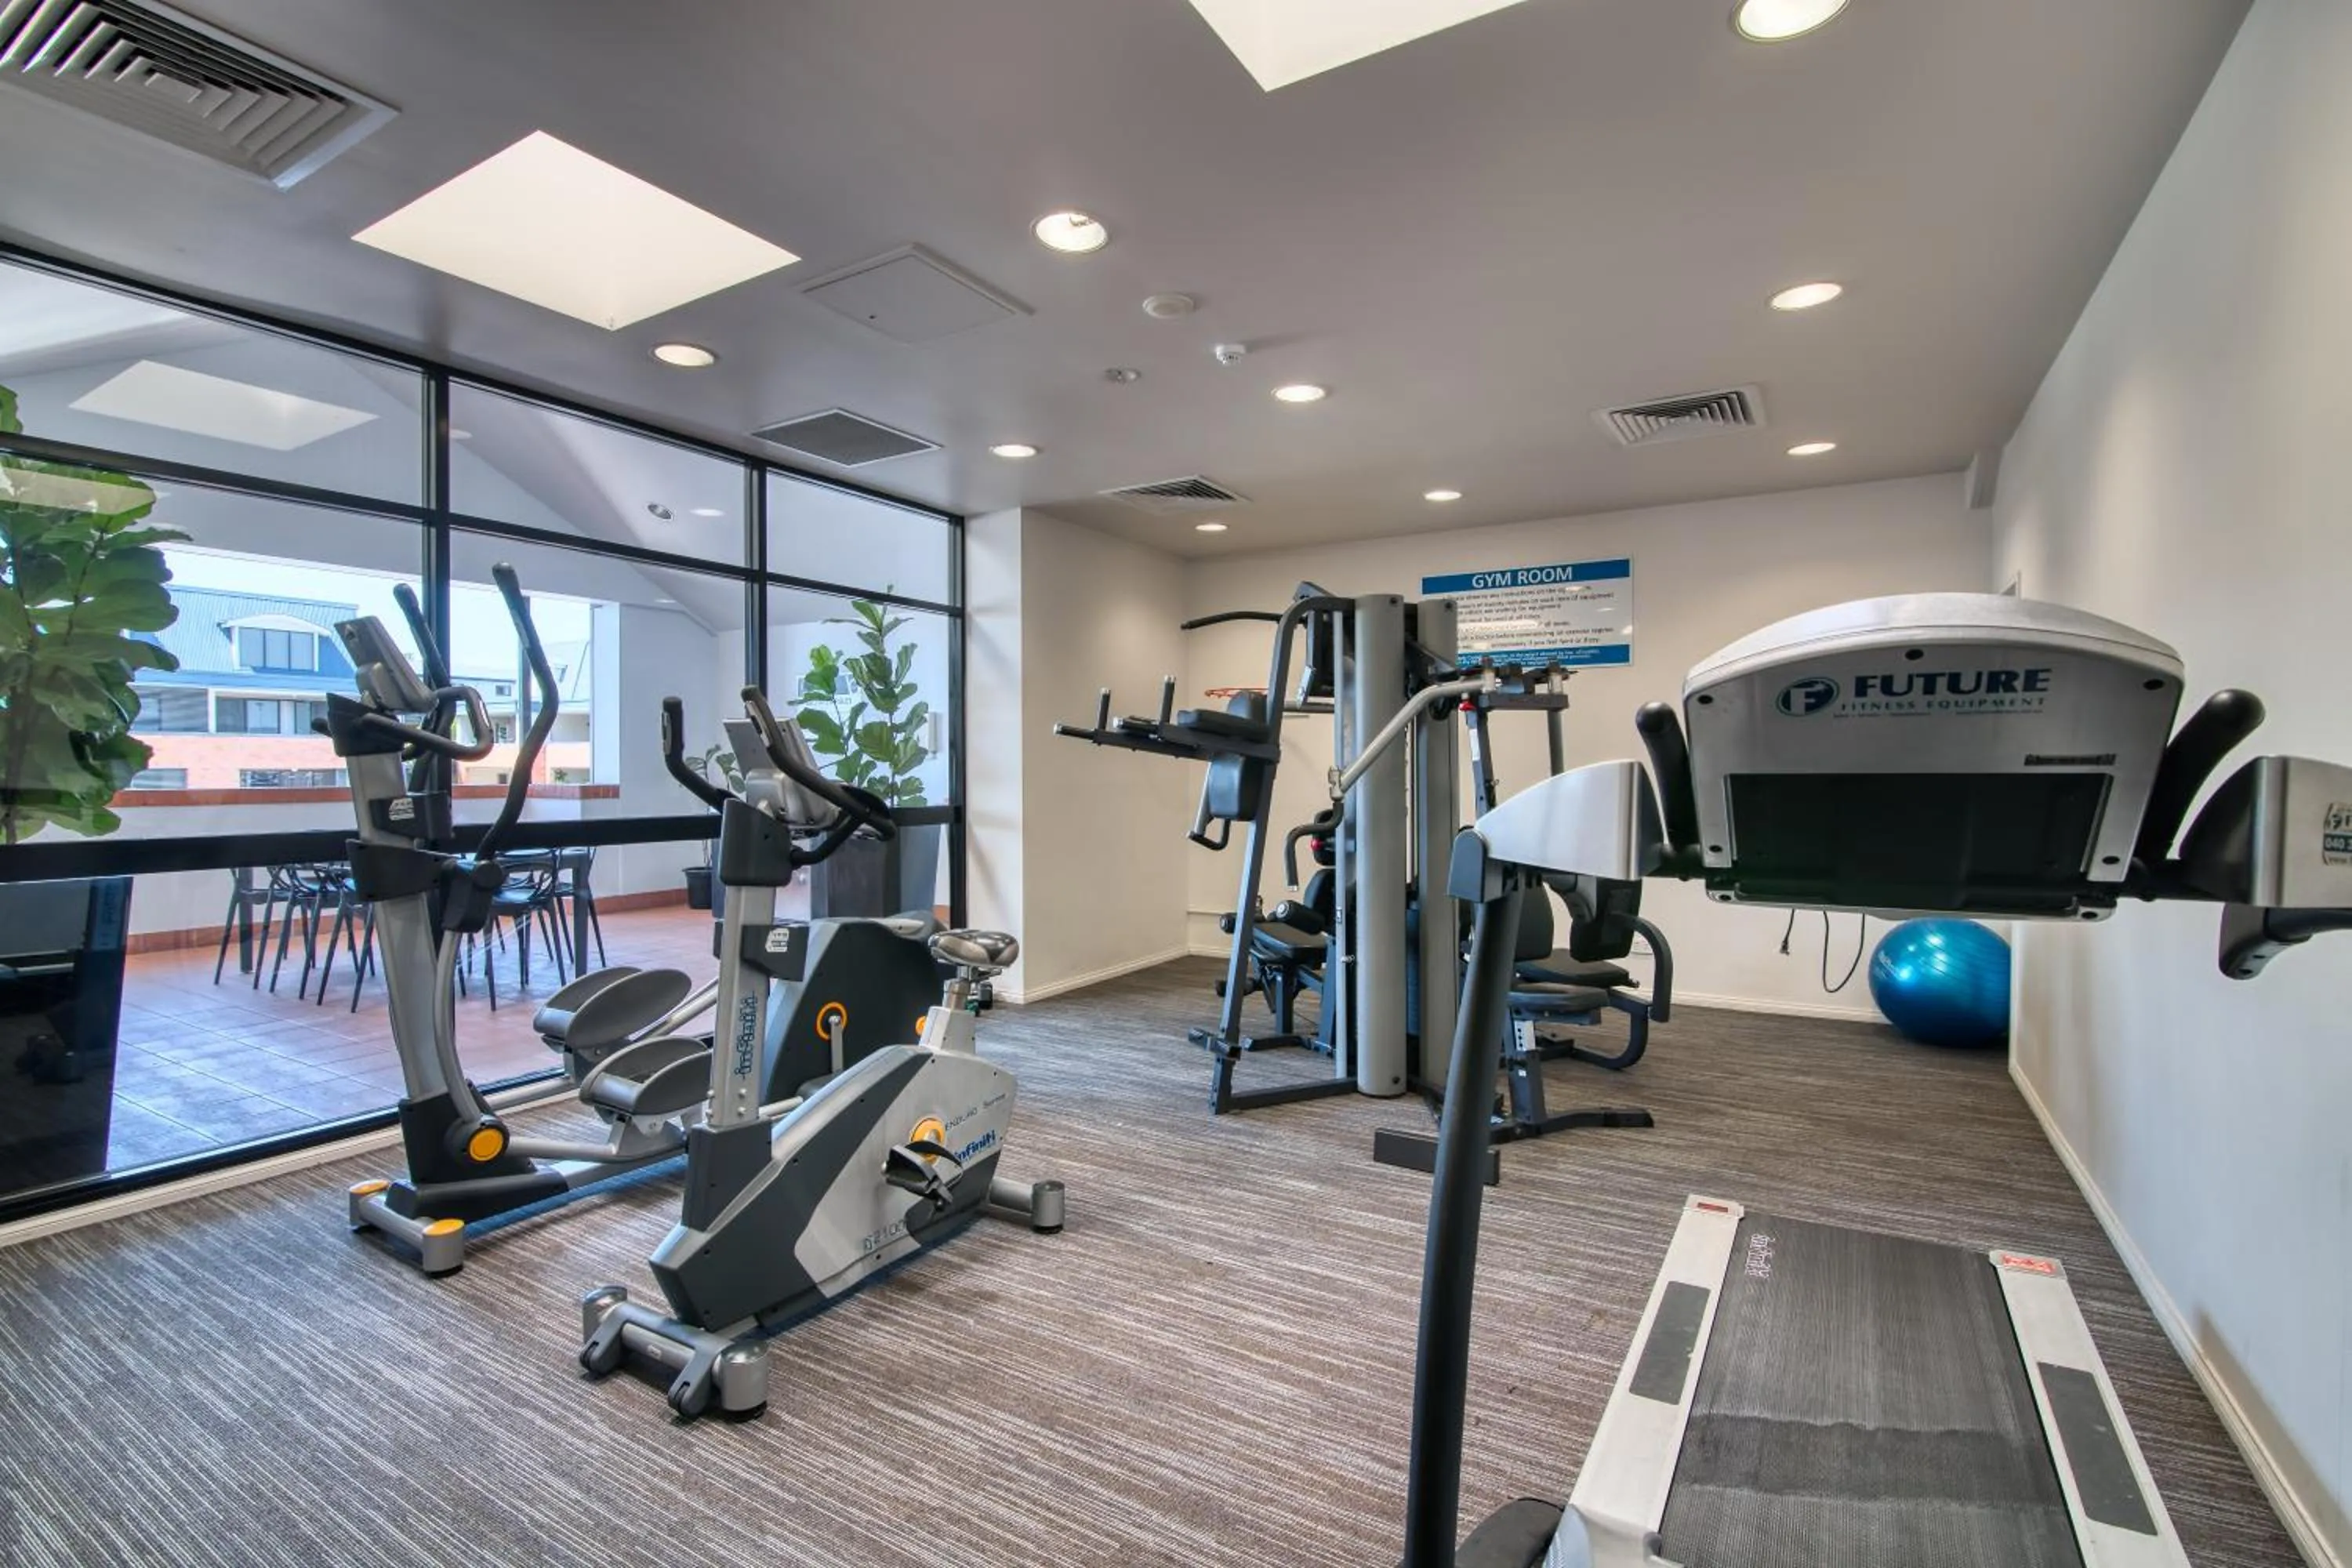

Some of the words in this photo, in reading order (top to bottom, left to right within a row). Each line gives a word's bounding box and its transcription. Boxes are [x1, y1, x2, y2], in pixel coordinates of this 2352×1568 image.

[1472, 572, 1512, 588] GYM
[1518, 566, 1572, 584] ROOM
[1855, 669, 2052, 698] FUTURE
[1842, 701, 1915, 712] FITNESS
[1927, 697, 2044, 710] EQUIPMENT
